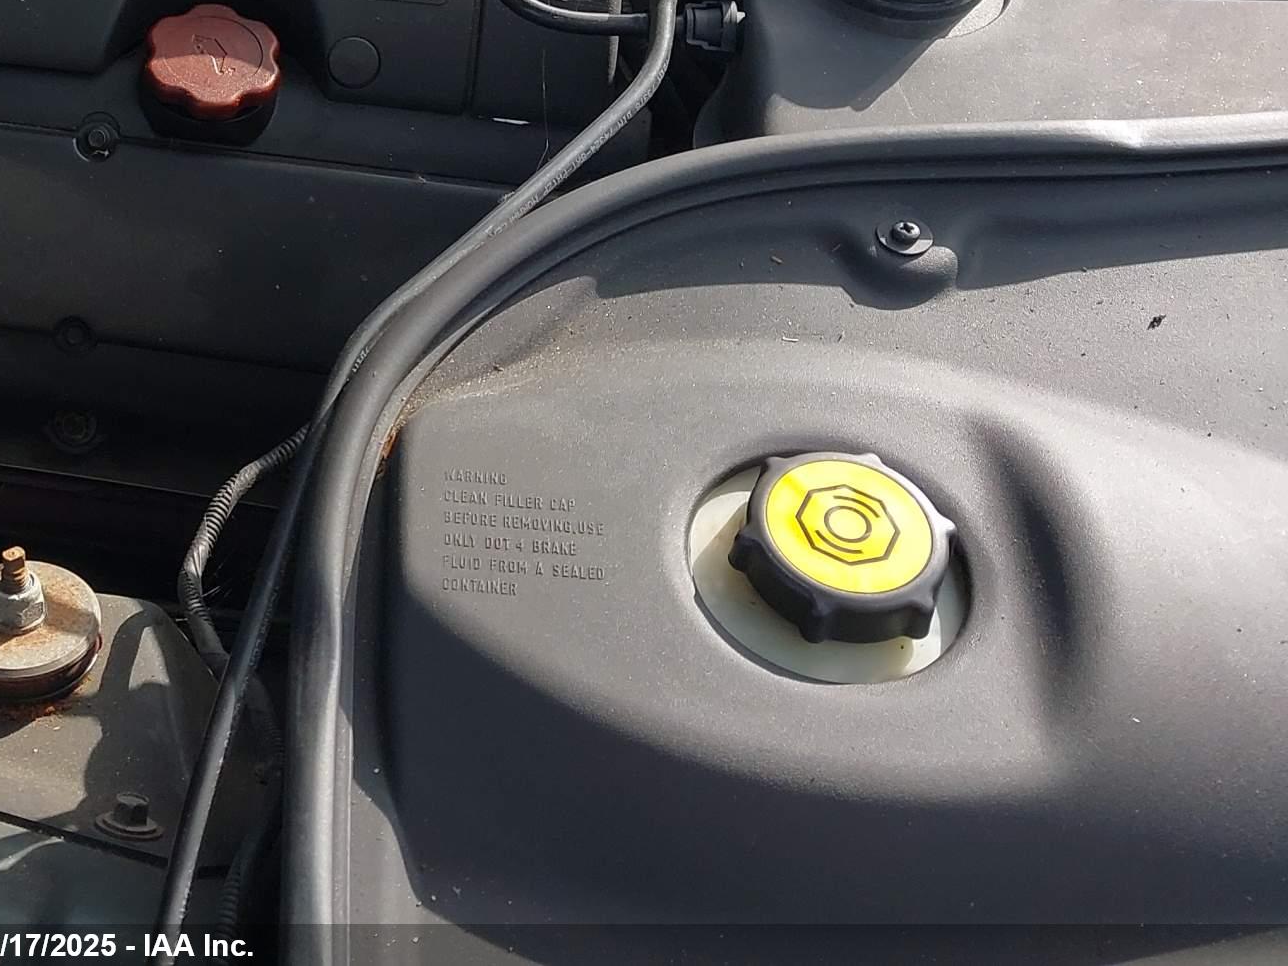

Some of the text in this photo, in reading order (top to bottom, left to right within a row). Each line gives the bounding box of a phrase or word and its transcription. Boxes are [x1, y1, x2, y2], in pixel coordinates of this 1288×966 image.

[444, 468, 509, 486] WARNING
[444, 489, 577, 512] CLEAN FILLER CAP
[443, 511, 497, 528] BEFORE
[444, 533, 578, 557] ONLY DOT 4 BRAKE
[442, 555, 606, 582] FLUID FROM A SEALED
[442, 577, 518, 597] CONTAINER
